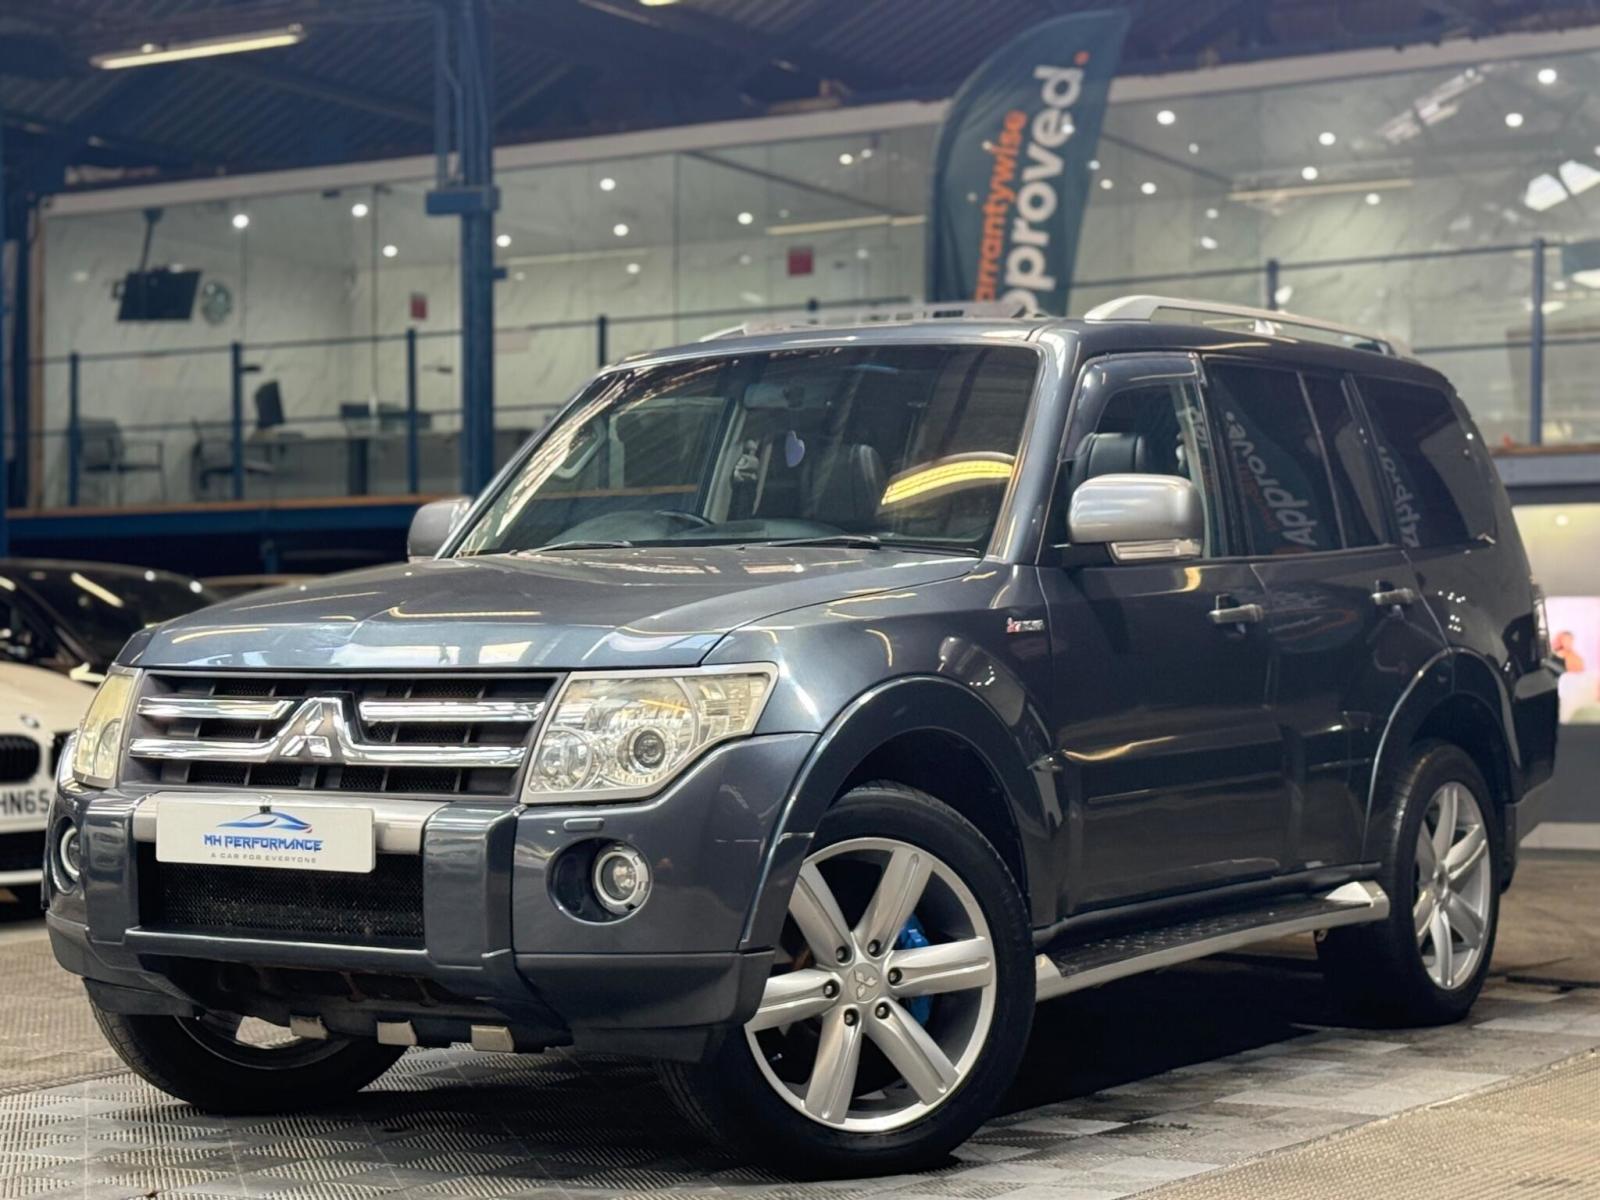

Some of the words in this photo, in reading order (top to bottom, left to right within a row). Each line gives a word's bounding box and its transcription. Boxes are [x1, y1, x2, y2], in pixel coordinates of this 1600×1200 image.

[976, 110, 1028, 302] arrantywise
[204, 835, 222, 846] MH
[225, 836, 323, 852] PERFORMANCE
[220, 852, 240, 860] CAR
[243, 853, 262, 861] FOR
[265, 855, 317, 864] EVERYONE
